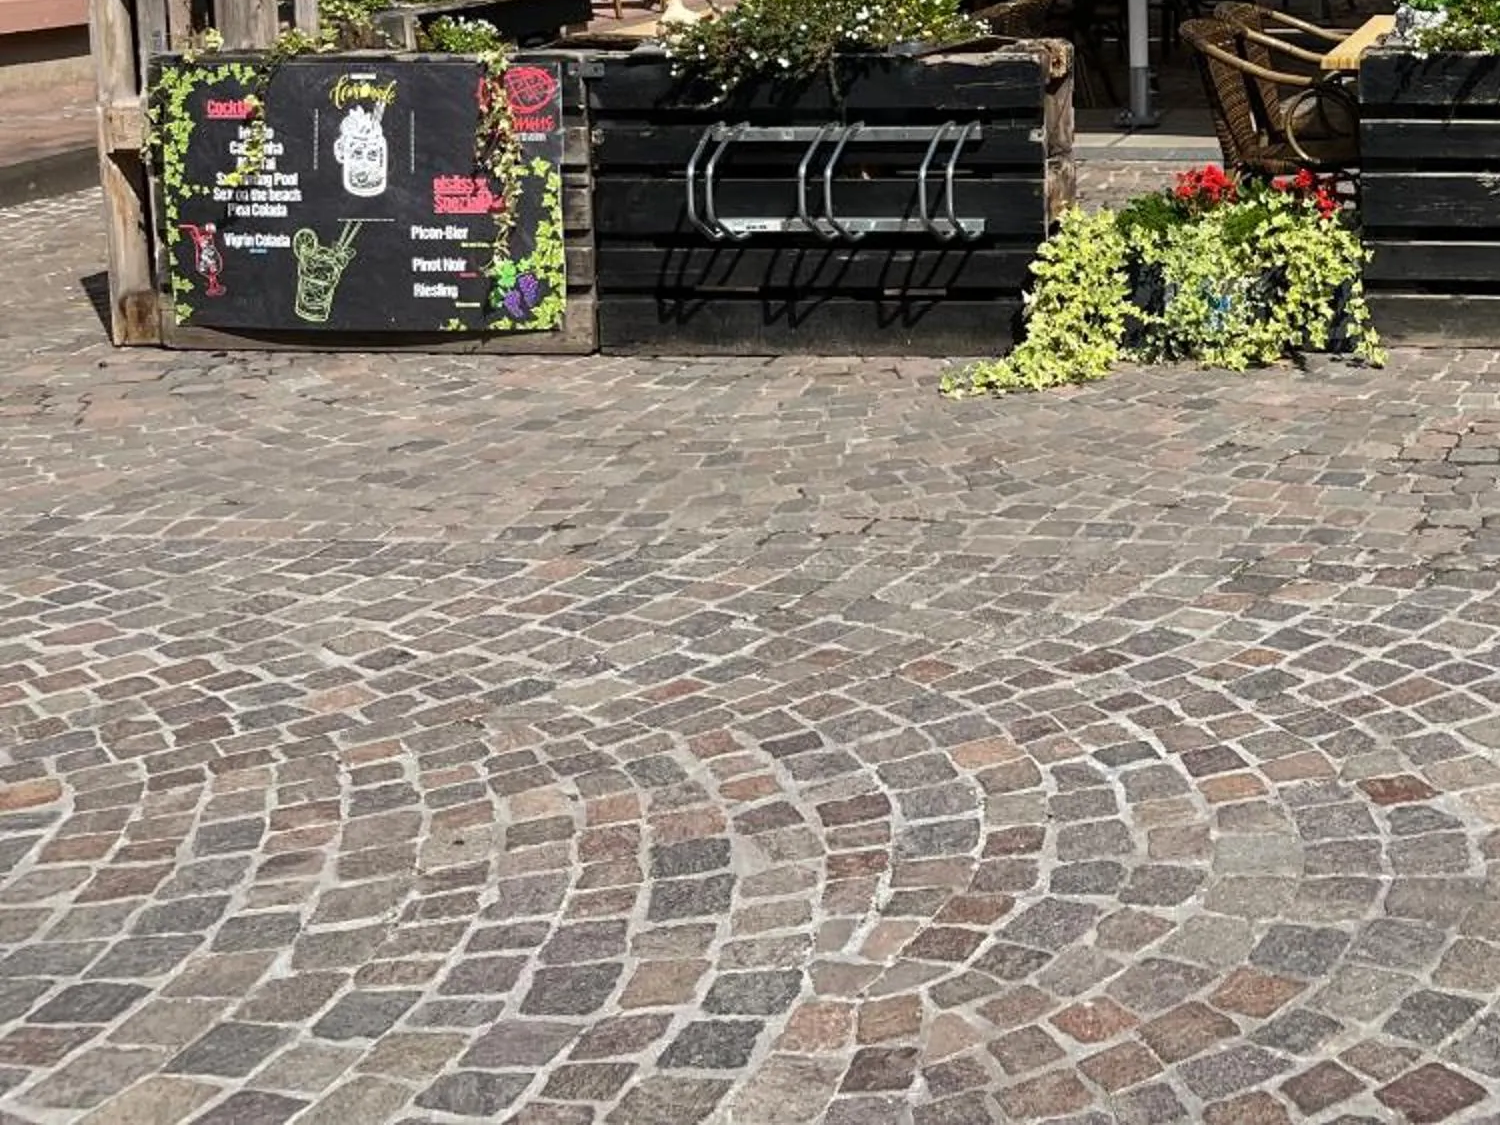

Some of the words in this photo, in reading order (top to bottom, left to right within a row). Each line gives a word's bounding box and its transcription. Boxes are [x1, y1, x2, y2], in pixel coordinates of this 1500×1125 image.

[250, 188, 267, 201] the
[268, 187, 303, 202] beach
[412, 257, 442, 272] Pinot
[443, 257, 468, 272] Noir
[413, 282, 459, 299] Riesling
